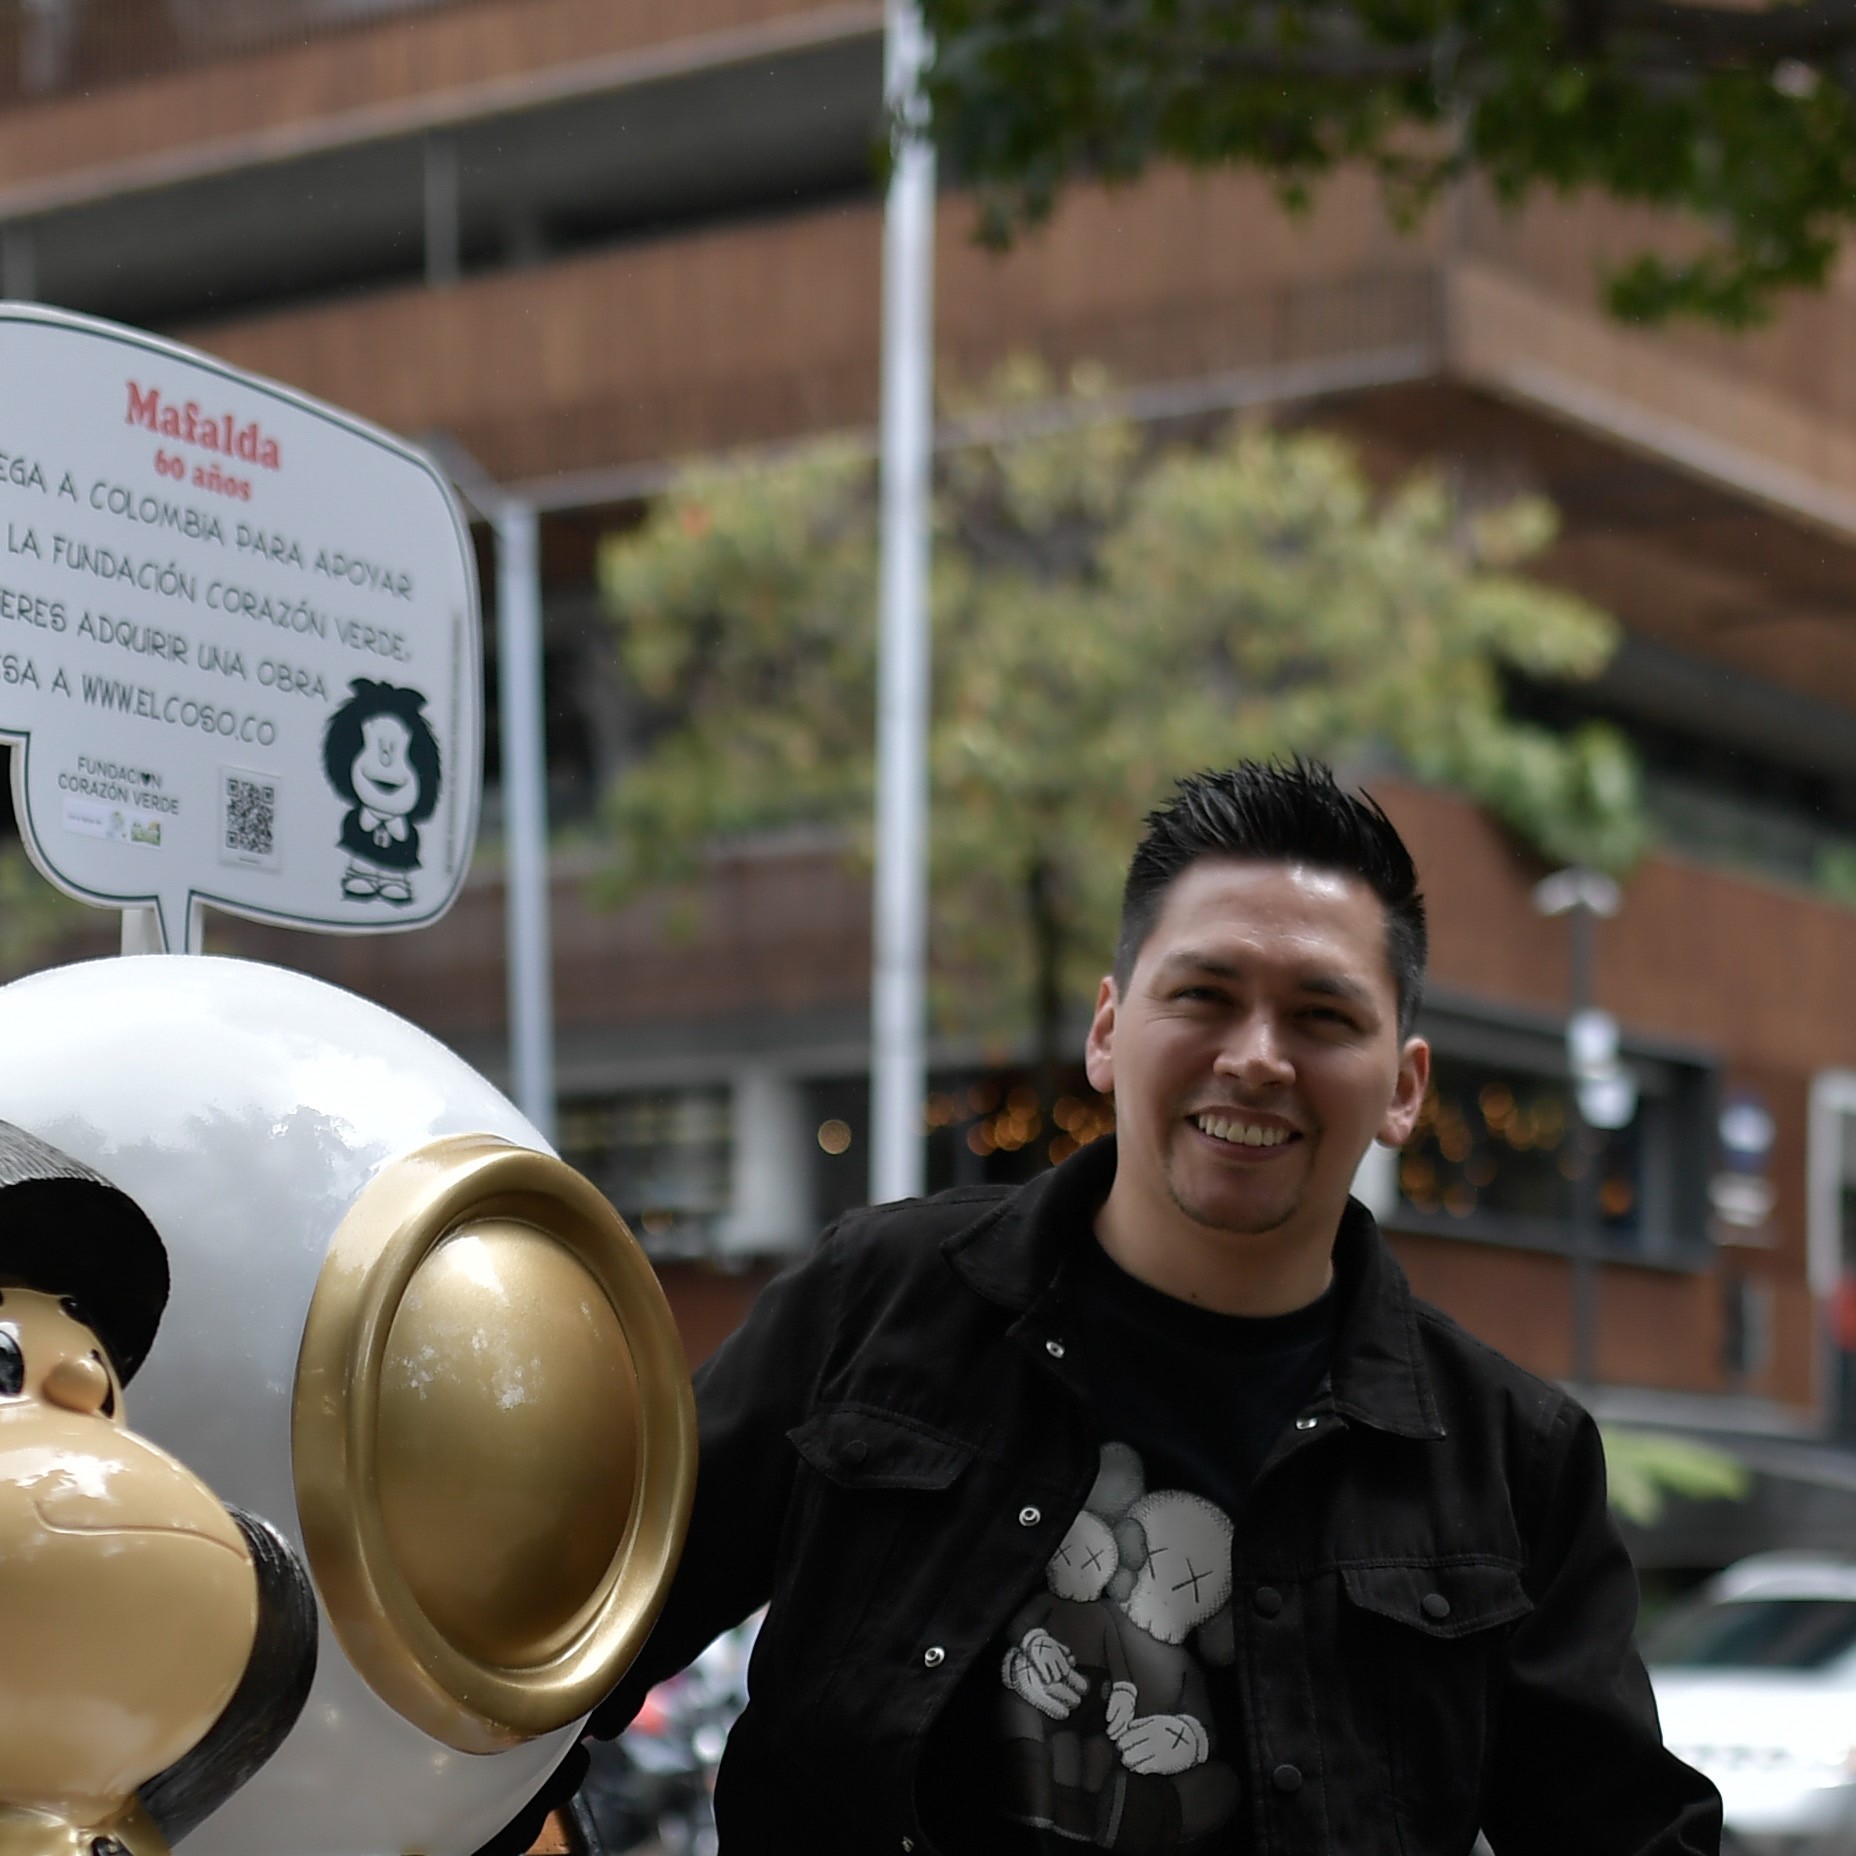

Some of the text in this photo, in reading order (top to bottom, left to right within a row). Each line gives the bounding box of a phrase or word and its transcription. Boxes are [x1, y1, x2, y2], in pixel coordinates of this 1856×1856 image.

[125, 380, 281, 470] Mafalda
[155, 449, 252, 501] 60 años
[57, 472, 78, 503] A
[235, 524, 305, 570] PARA
[313, 551, 413, 602] APOYAR
[8, 523, 41, 560] LA
[206, 581, 327, 640] CORAZÓN
[51, 667, 72, 699] A
[82, 674, 276, 747] WWW.ELCOSO.CO
[197, 643, 247, 681] UNA
[257, 660, 329, 703] OBRA
[57, 772, 180, 816] CORAZÓN VERDE
